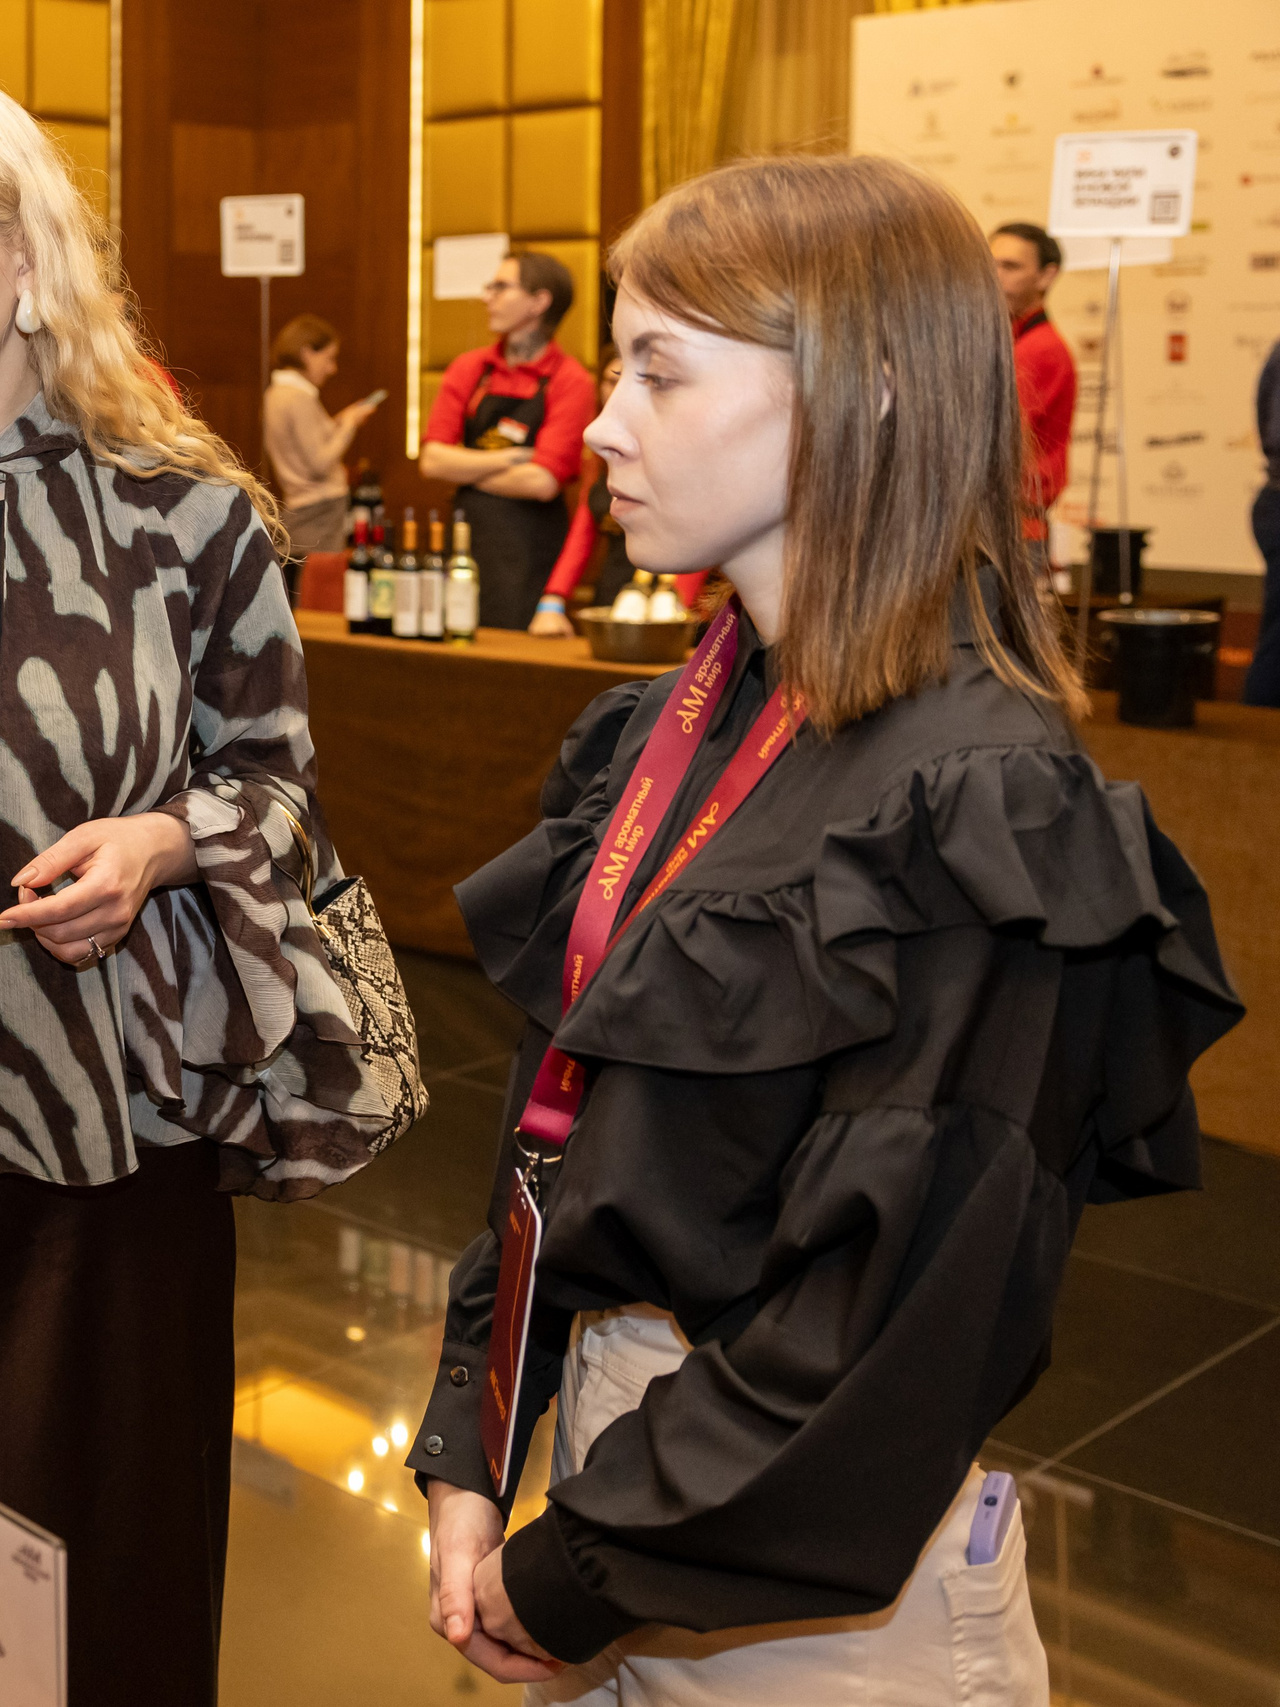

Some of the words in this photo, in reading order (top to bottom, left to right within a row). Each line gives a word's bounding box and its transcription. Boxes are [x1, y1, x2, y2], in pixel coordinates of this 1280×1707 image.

[694, 613, 737, 683] ароматный
[704, 661, 723, 688] мир
[613, 776, 654, 849] ароматный
[625, 824, 645, 852] мир
